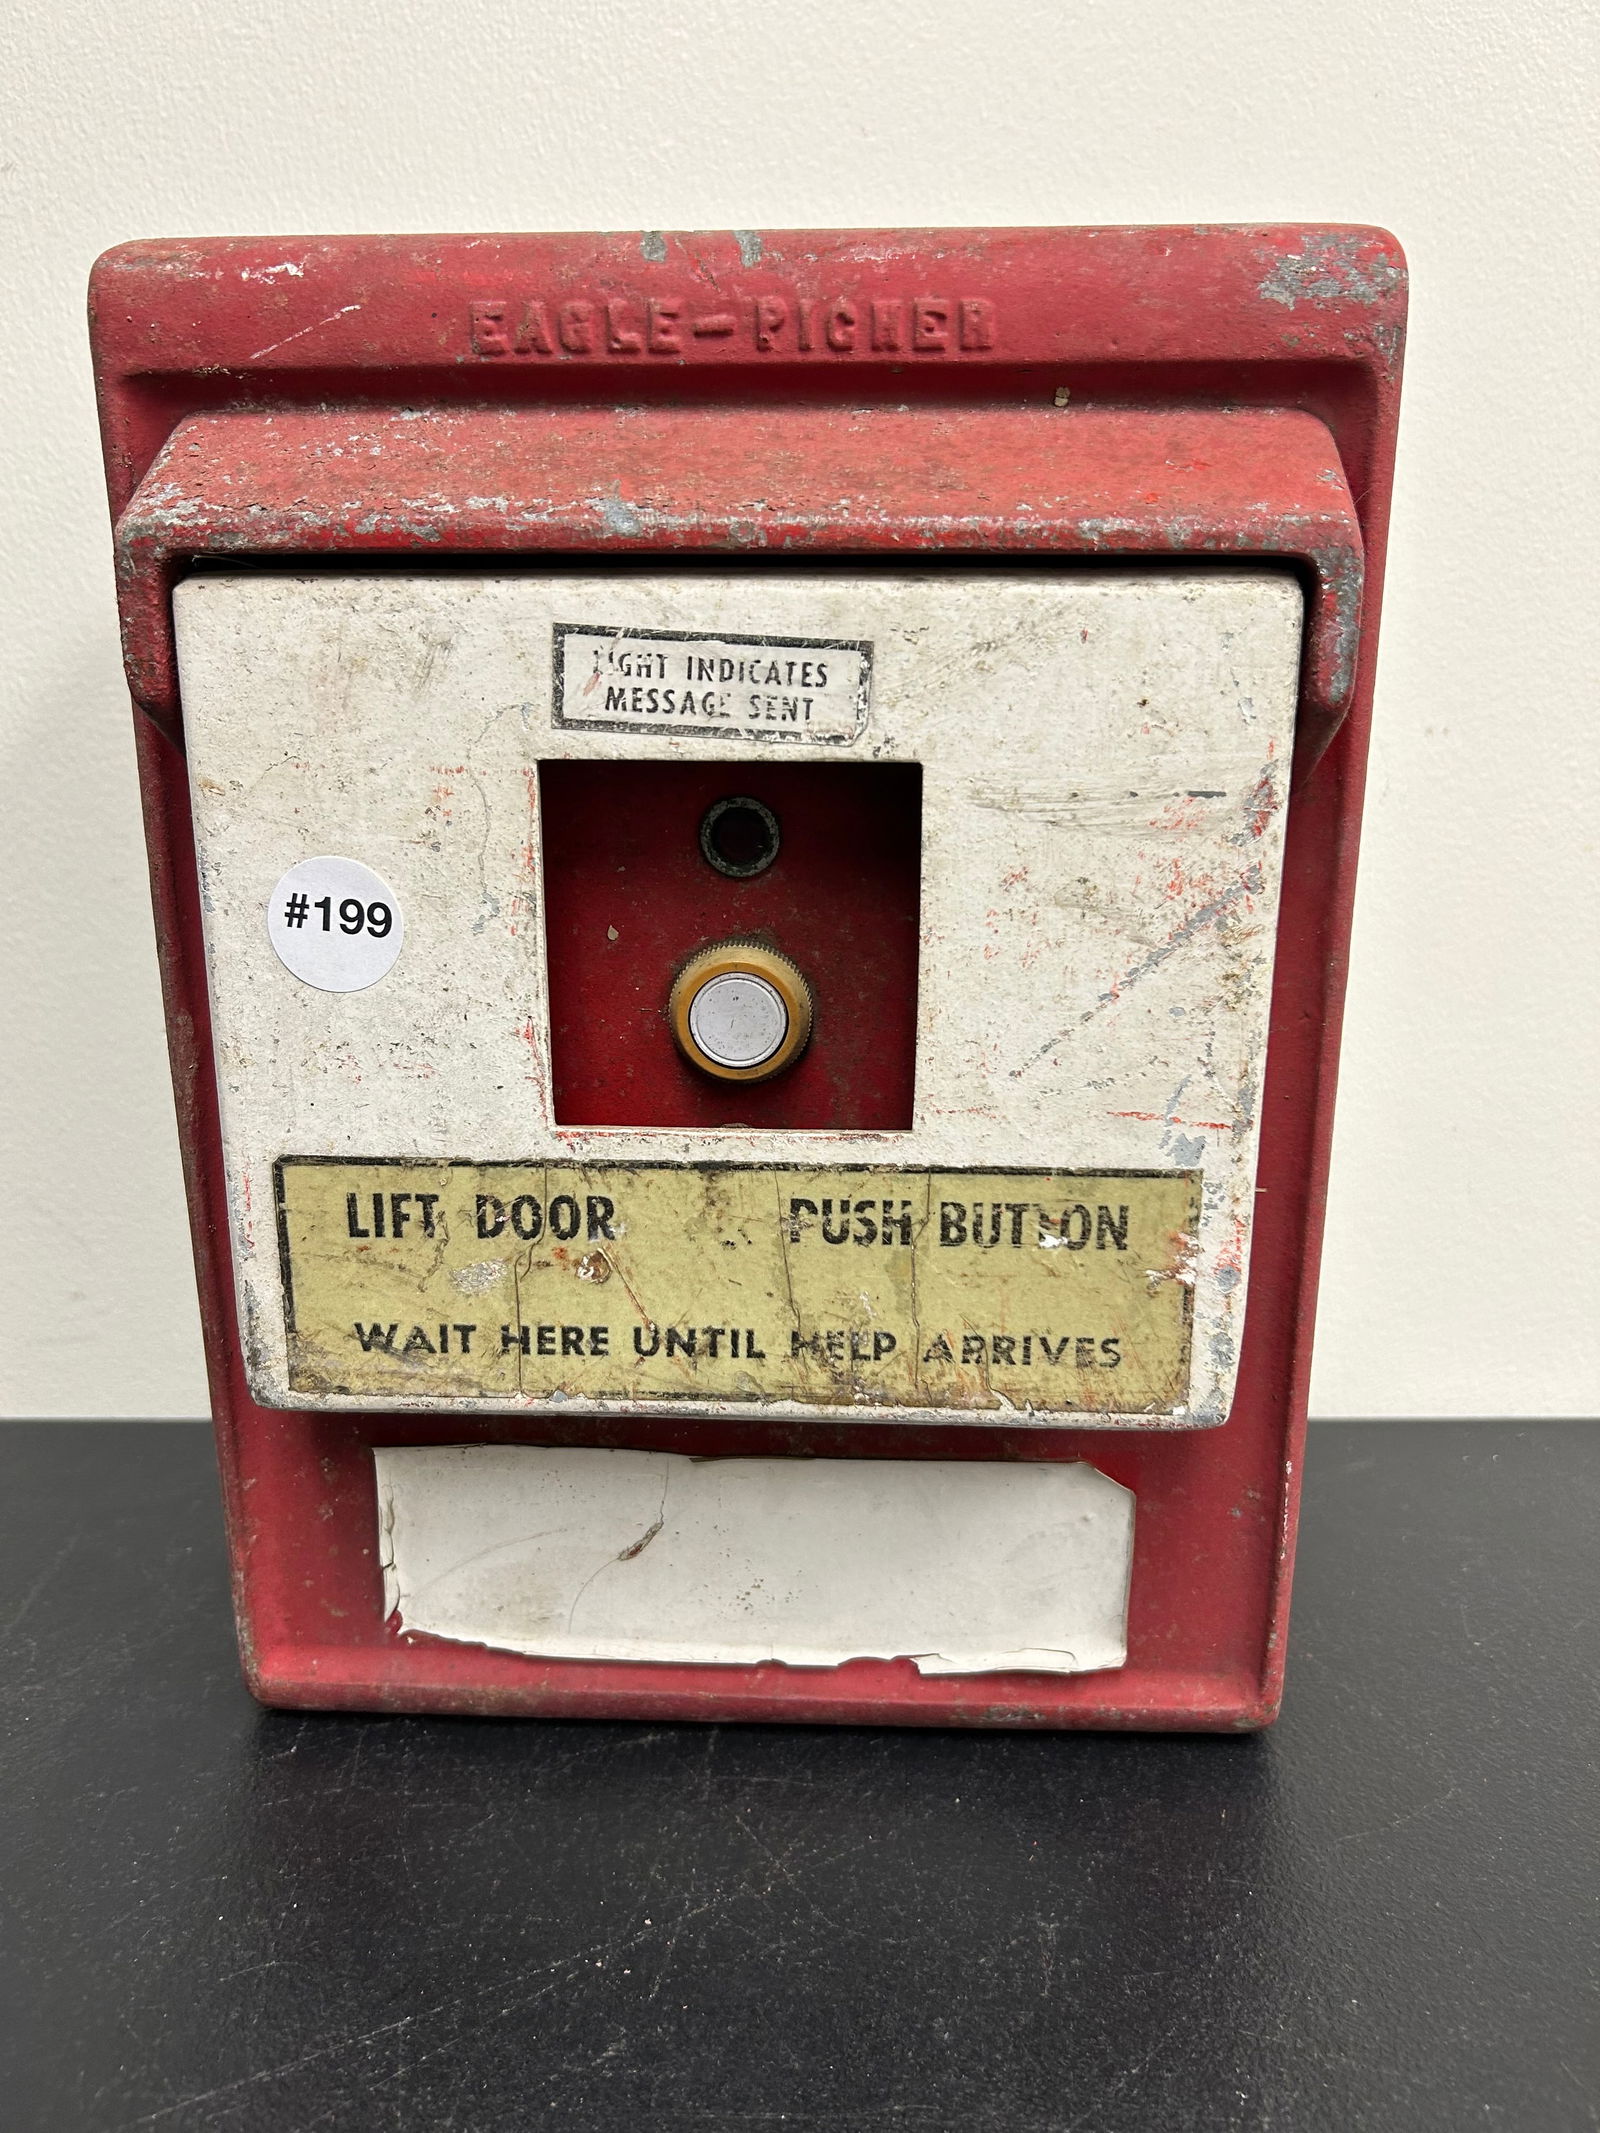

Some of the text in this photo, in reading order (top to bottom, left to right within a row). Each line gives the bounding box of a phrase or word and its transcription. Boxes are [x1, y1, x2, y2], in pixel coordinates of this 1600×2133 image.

[470, 298, 997, 354] EAGLE-PICHER
[686, 655, 829, 688] INDICATES
[604, 686, 815, 721] MESSAGE SENT
[284, 893, 392, 938] #199
[346, 1192, 616, 1241] LIFT DOOR
[790, 1198, 912, 1246] PUSH
[354, 1321, 1122, 1368] WAIT HERE UNTIL HELP ARRIVES
